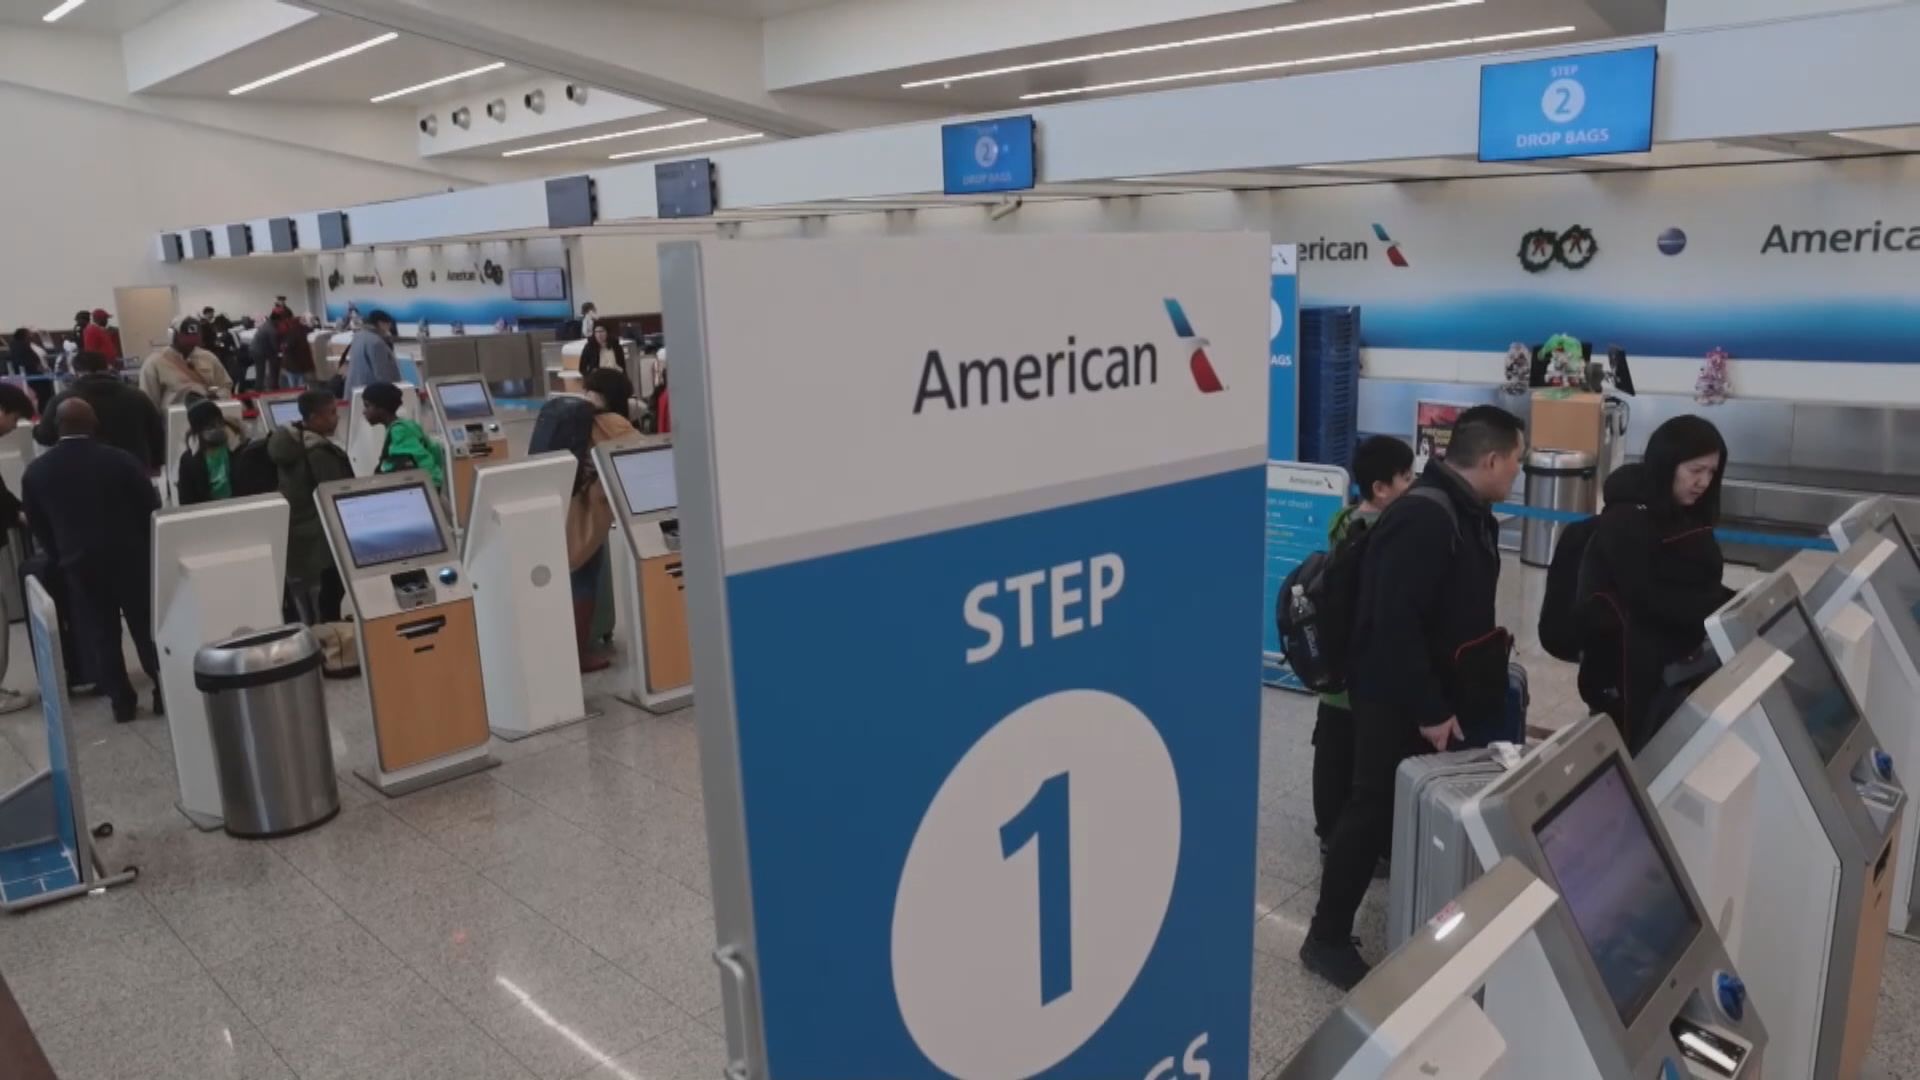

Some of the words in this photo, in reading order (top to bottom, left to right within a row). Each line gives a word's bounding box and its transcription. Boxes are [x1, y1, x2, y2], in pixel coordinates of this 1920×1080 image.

[1550, 64, 1579, 78] STEP
[1554, 88, 1571, 115] 2
[1516, 131, 1561, 148] DROP
[1564, 128, 1609, 145] BAGS
[1760, 219, 1920, 254] America
[912, 335, 1158, 415] American
[963, 552, 1126, 664] STEP
[999, 770, 1073, 1009] 1
